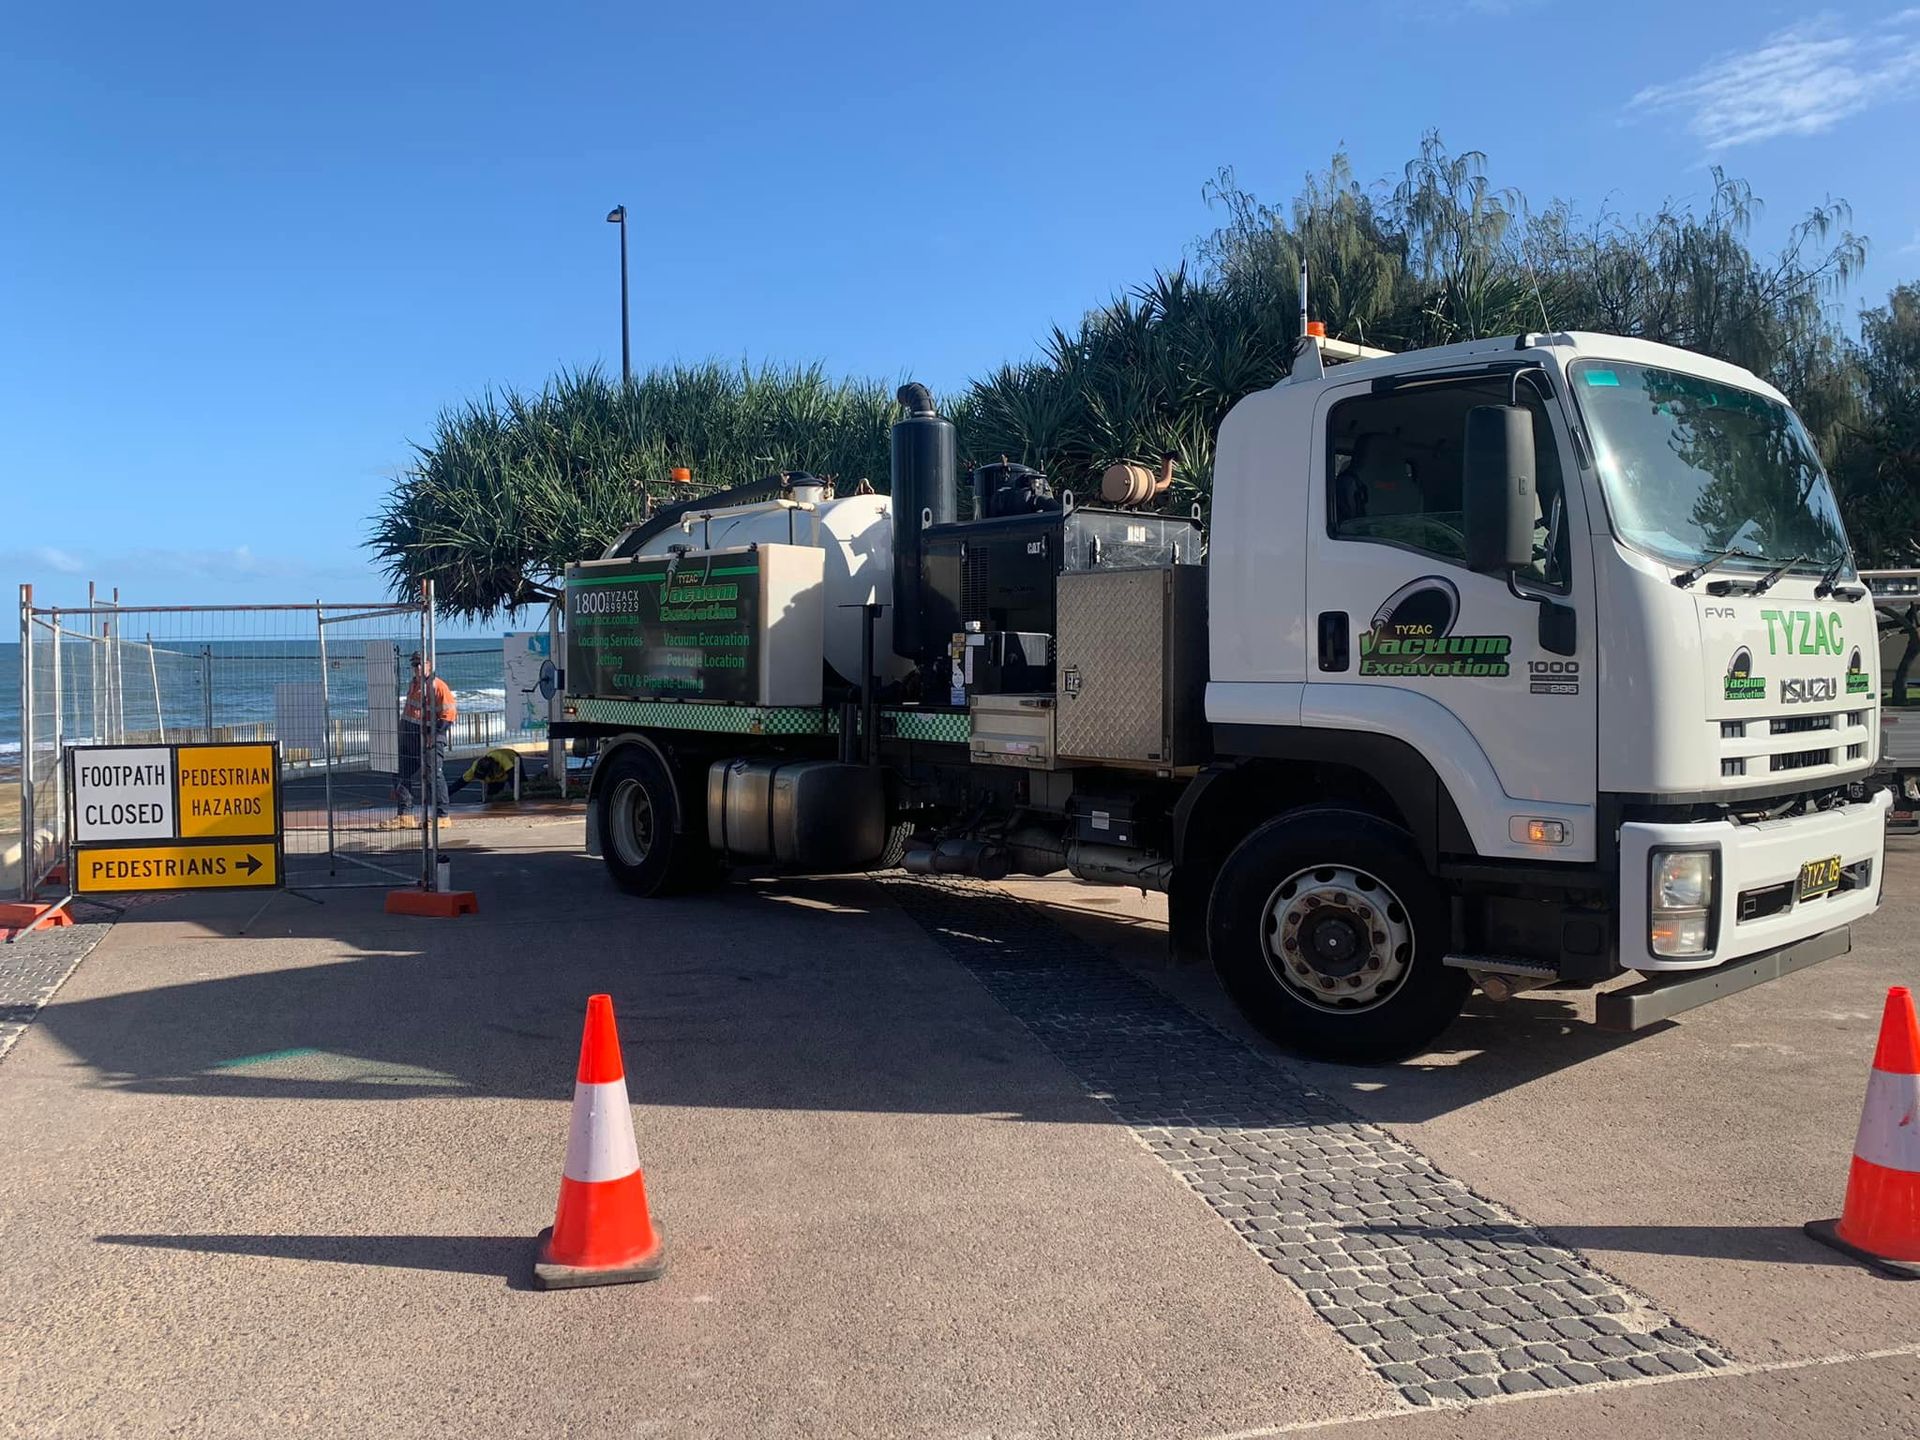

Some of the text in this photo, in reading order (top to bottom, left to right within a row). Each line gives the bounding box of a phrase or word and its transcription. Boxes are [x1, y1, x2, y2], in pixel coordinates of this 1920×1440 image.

[678, 574, 699, 585] TYZAC
[574, 591, 606, 614] 1800
[605, 590, 639, 602] TYZACX
[605, 601, 639, 613] 899229
[1704, 607, 1736, 618] FVR
[664, 631, 750, 647] Vacuum Excavation
[1395, 625, 1433, 635] TYZAC
[1760, 610, 1844, 655] TYZAC
[578, 633, 643, 649] Locating Services
[1359, 631, 1510, 656] Vacuum
[666, 652, 745, 668] Pot Hole Location
[1360, 657, 1509, 676] Excavation
[1527, 661, 1580, 674] 1000
[1550, 685, 1577, 693] 295
[1779, 677, 1837, 704] ISUZU
[81, 764, 165, 787] FOOTPATH
[181, 767, 270, 787] PEDESTRIAN
[86, 803, 163, 825] CLOSED
[191, 797, 261, 816] HAZARDS
[91, 857, 227, 879] PEDESTRIANS
[1807, 863, 1825, 888] TYZ
